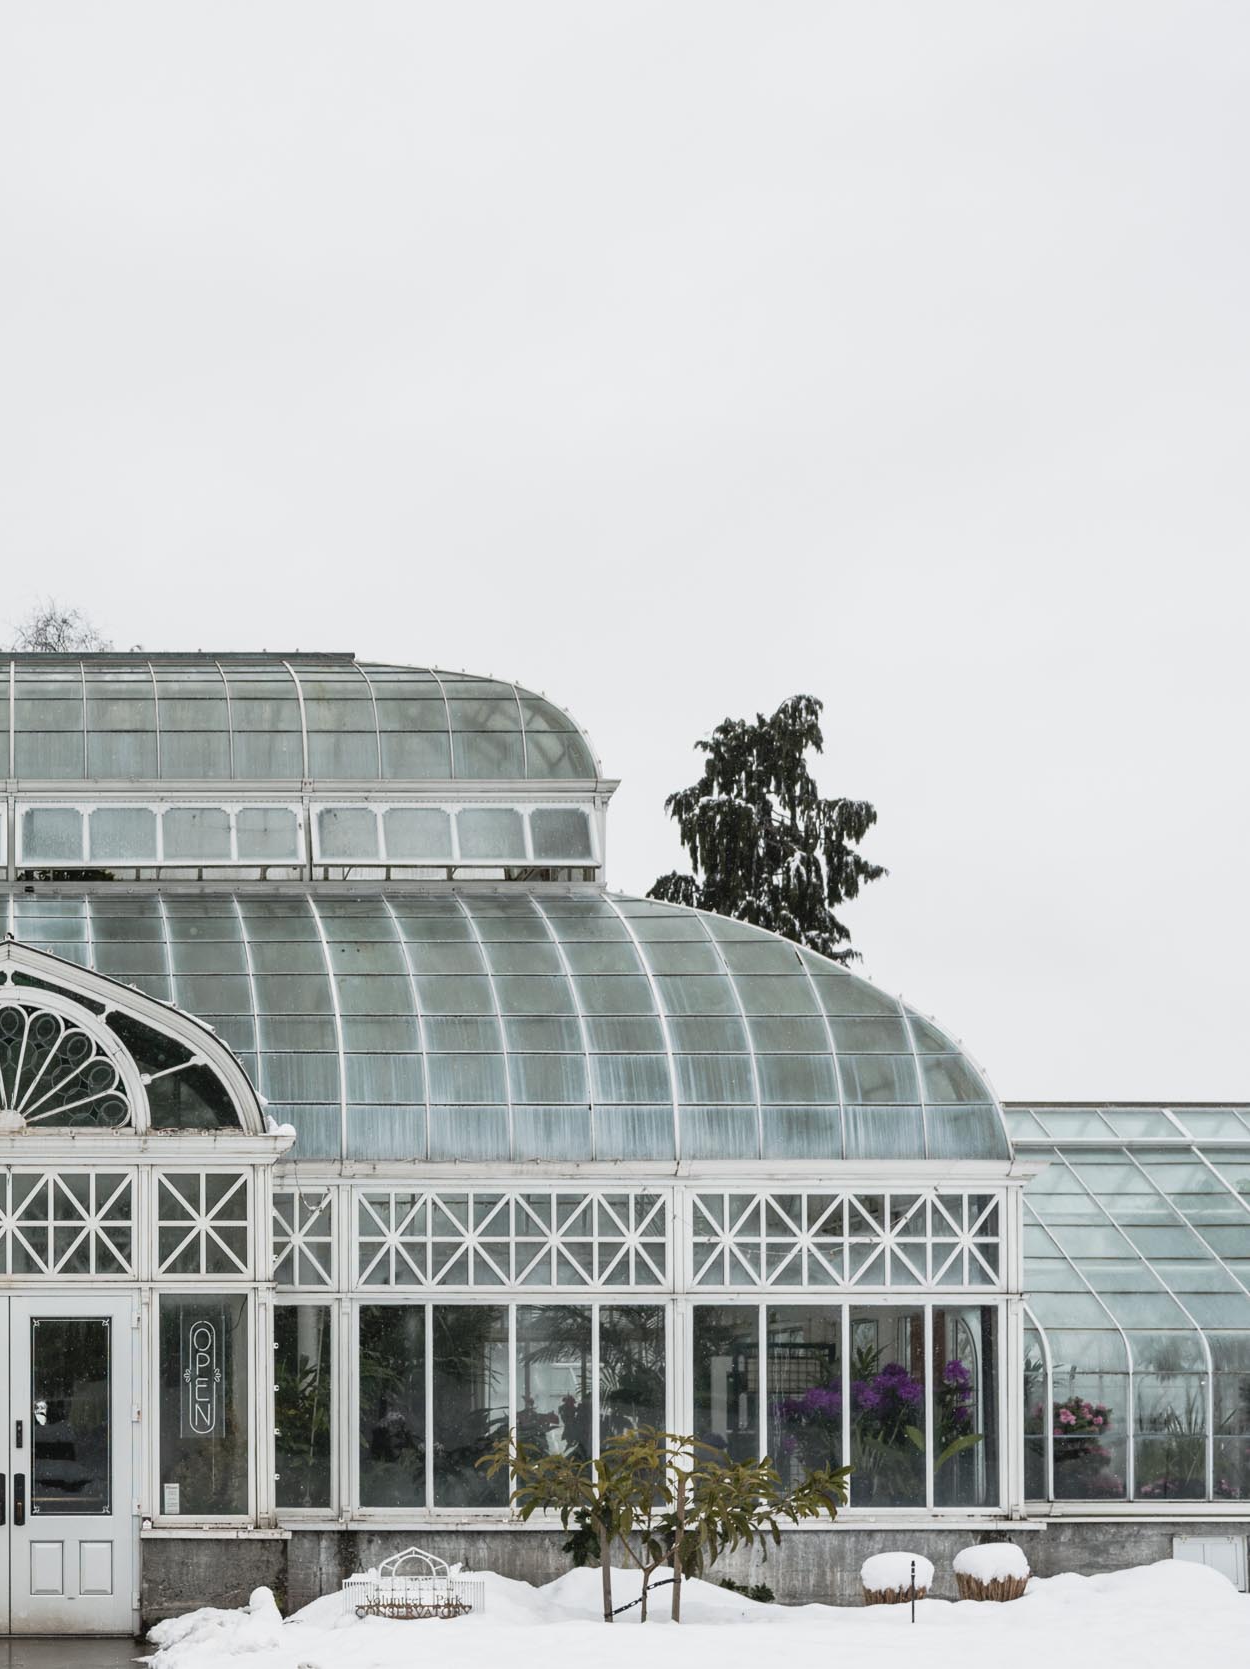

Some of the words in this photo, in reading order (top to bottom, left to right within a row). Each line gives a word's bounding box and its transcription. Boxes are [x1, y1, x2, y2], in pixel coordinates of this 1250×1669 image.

[193, 1328, 212, 1426] OPEN
[365, 1594, 424, 1606] Volunteer
[435, 1594, 463, 1606] Park
[355, 1605, 473, 1620] CONSERVATORY
